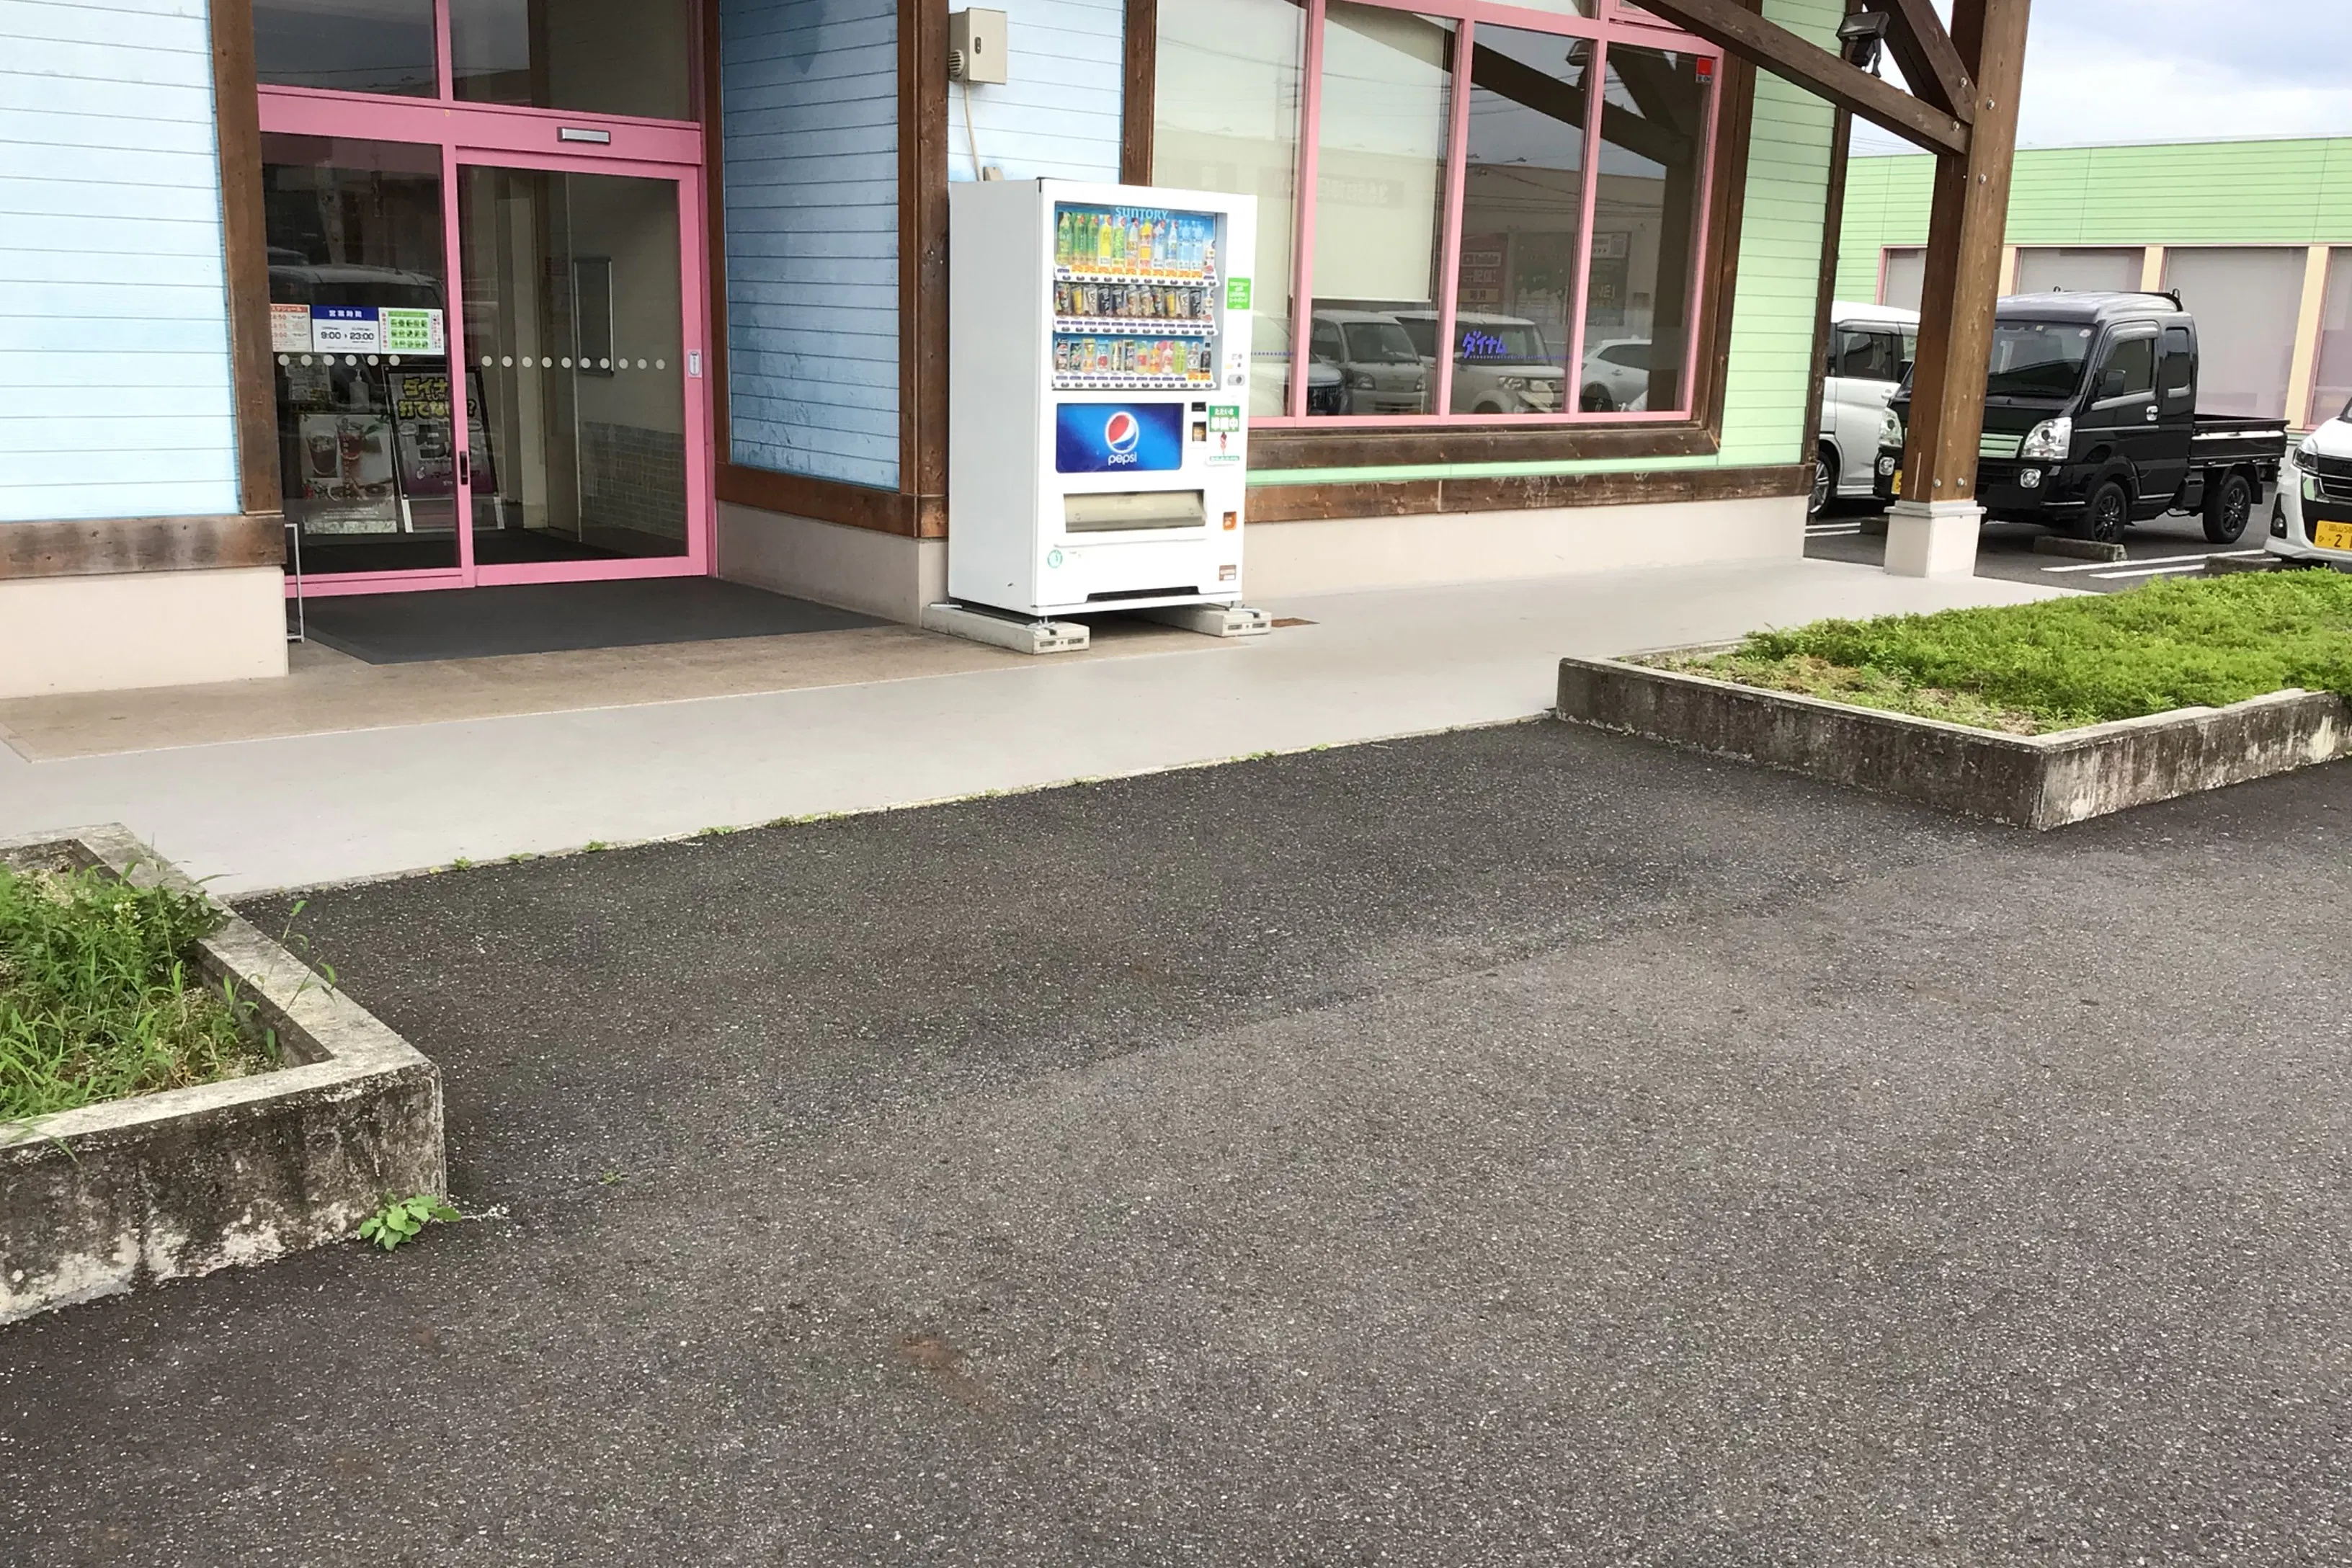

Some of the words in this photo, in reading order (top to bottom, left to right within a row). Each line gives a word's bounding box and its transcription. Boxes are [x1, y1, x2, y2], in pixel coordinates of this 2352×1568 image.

[321, 331, 342, 339] 9:00
[349, 331, 375, 341] 23:00
[1462, 330, 1508, 359] ダイナム
[1108, 451, 1138, 466] pepsi
